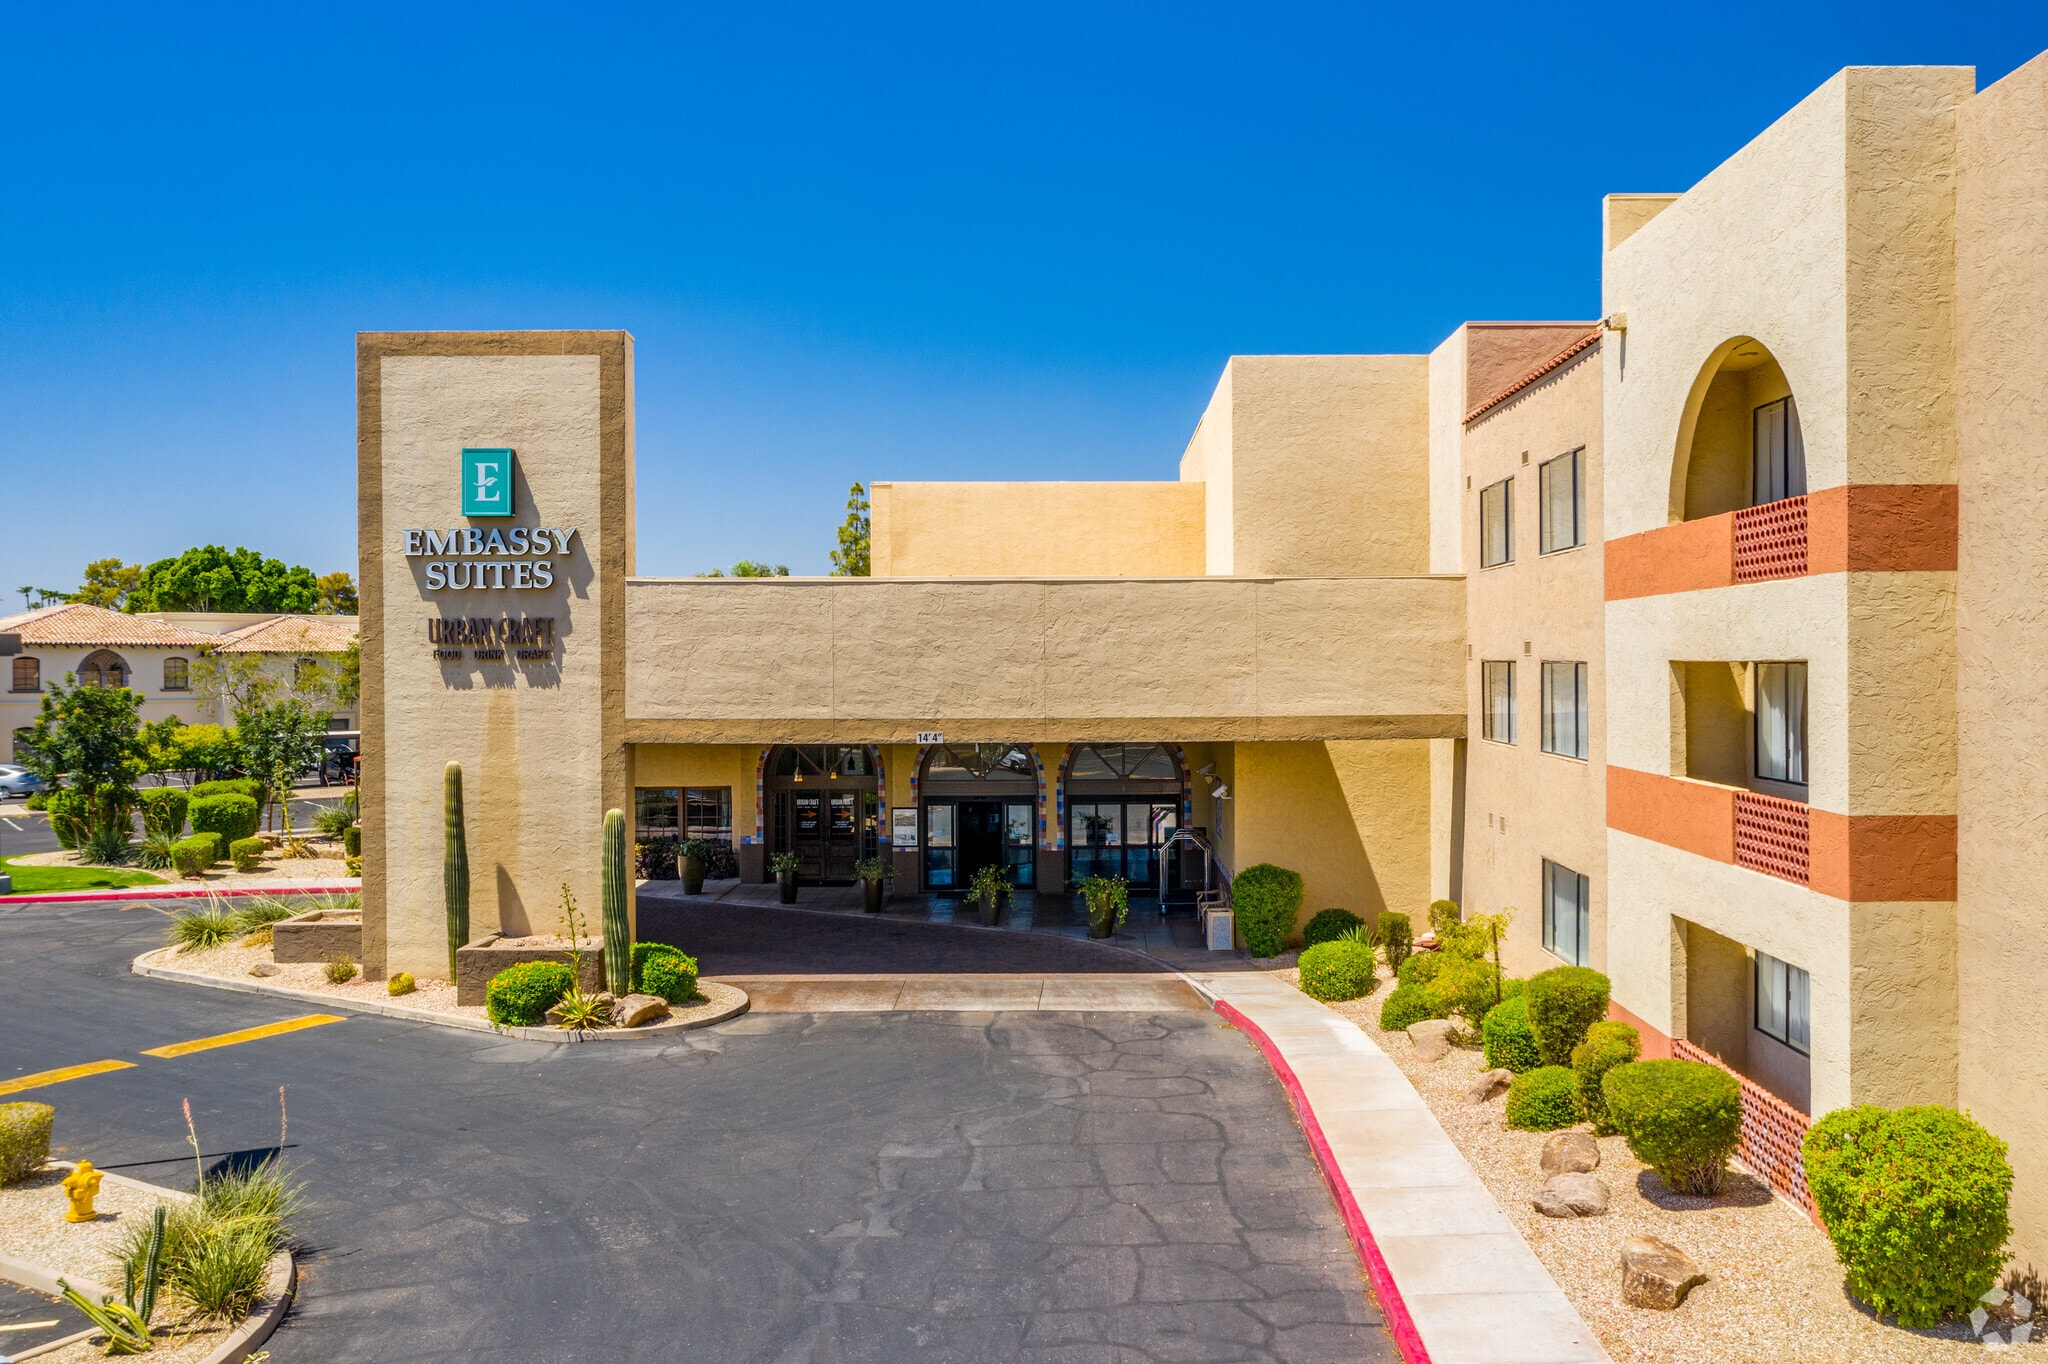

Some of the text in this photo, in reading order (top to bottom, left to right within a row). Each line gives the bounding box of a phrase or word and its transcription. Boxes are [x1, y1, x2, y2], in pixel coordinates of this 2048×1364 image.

[473, 462, 500, 502] E
[402, 527, 577, 556] EMBASSY
[425, 560, 554, 590] SUITES
[428, 617, 554, 644] URBAN CRAFT
[433, 649, 550, 659] FOOD DRINK DRAFT
